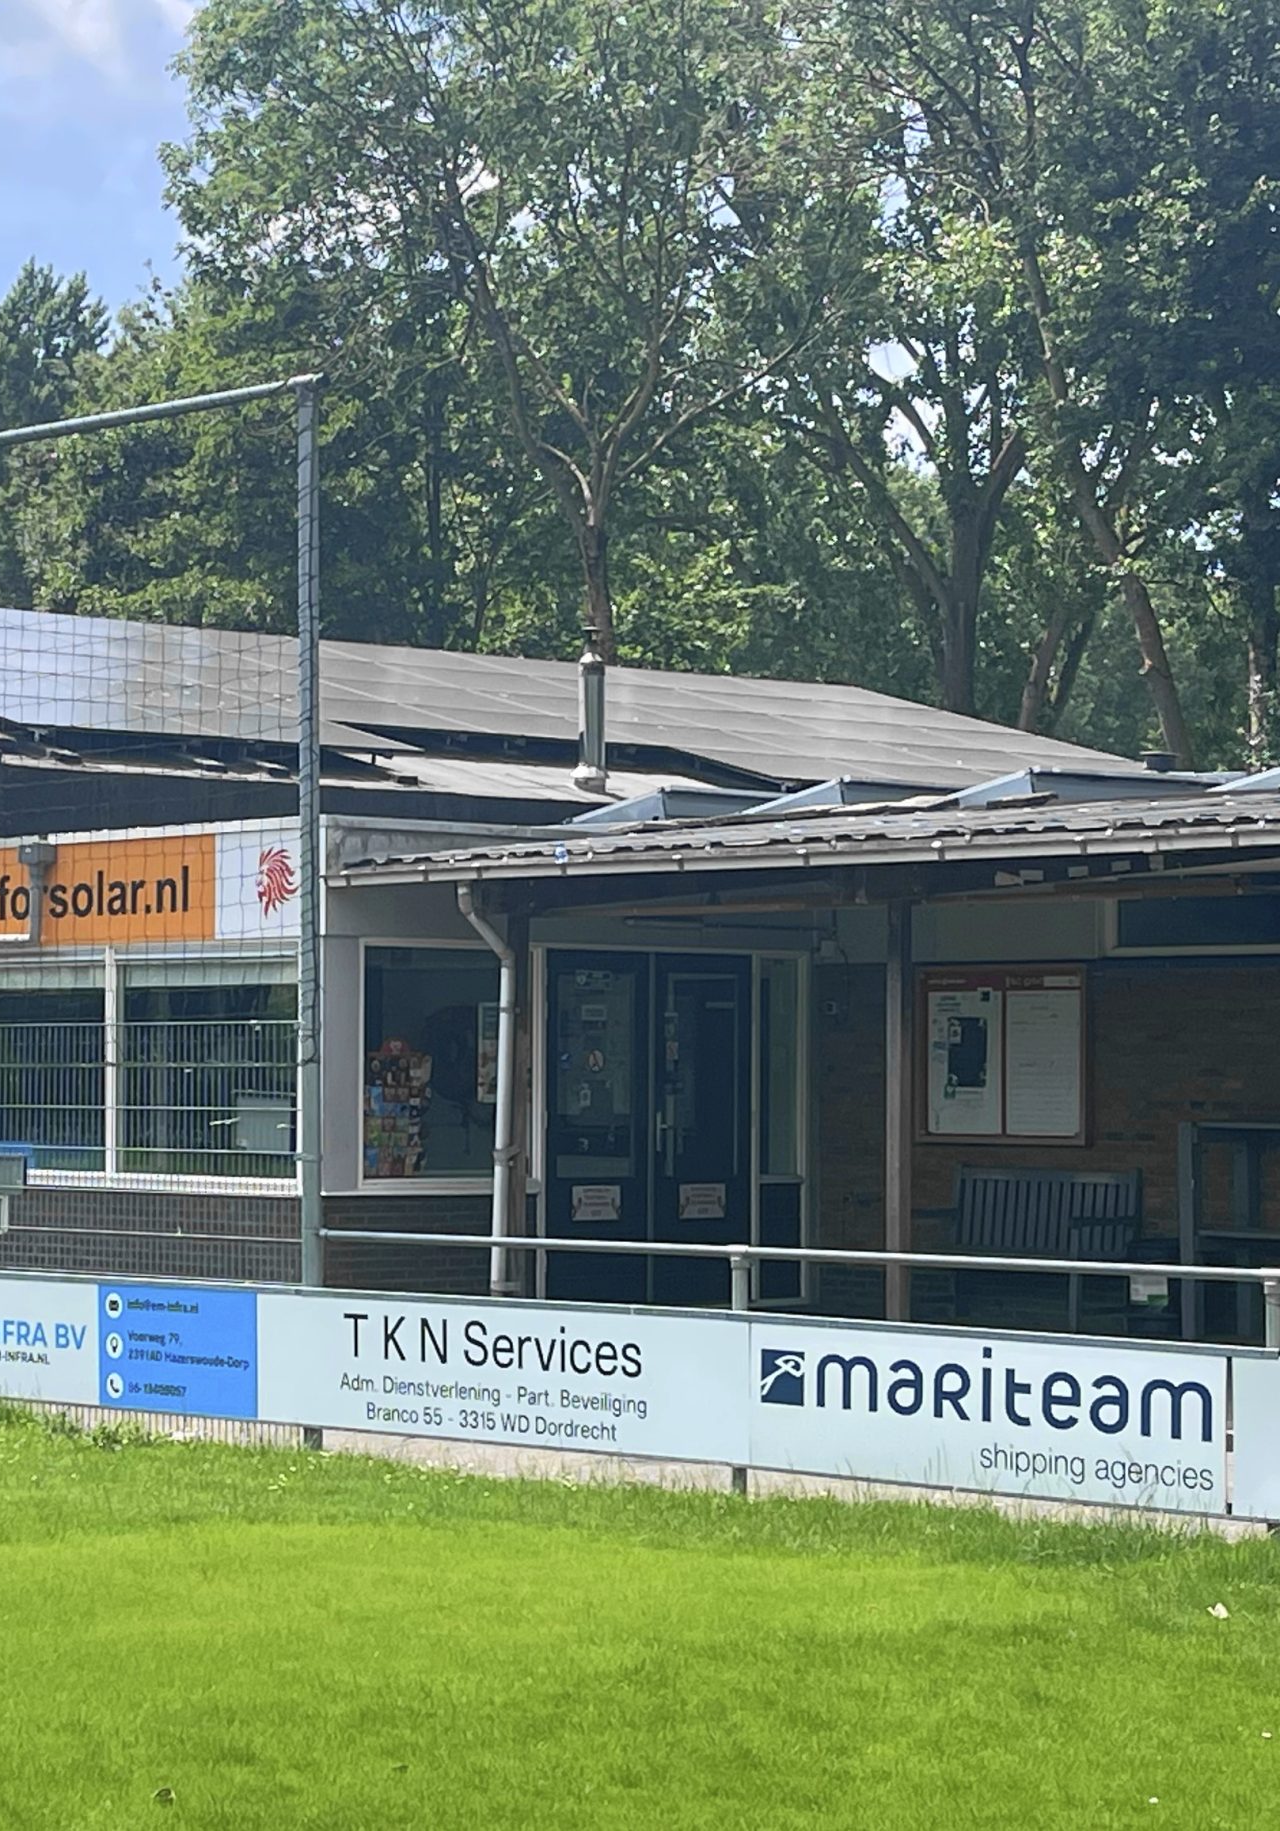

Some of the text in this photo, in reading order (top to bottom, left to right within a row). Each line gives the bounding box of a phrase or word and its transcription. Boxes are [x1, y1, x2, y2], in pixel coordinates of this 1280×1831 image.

[55, 1324, 88, 1350] BV
[463, 1320, 642, 1378] Services
[340, 1372, 378, 1393] Adm.
[382, 1375, 501, 1407] Dienstverlening
[517, 1386, 555, 1407] Part.
[560, 1389, 648, 1420] Beveiliging
[366, 1402, 419, 1424] Branco
[423, 1407, 443, 1426] 55
[459, 1409, 496, 1431] 3315
[500, 1413, 530, 1434] WD
[535, 1416, 617, 1442] Dordrecht
[980, 1443, 1214, 1491] shipping agencies
